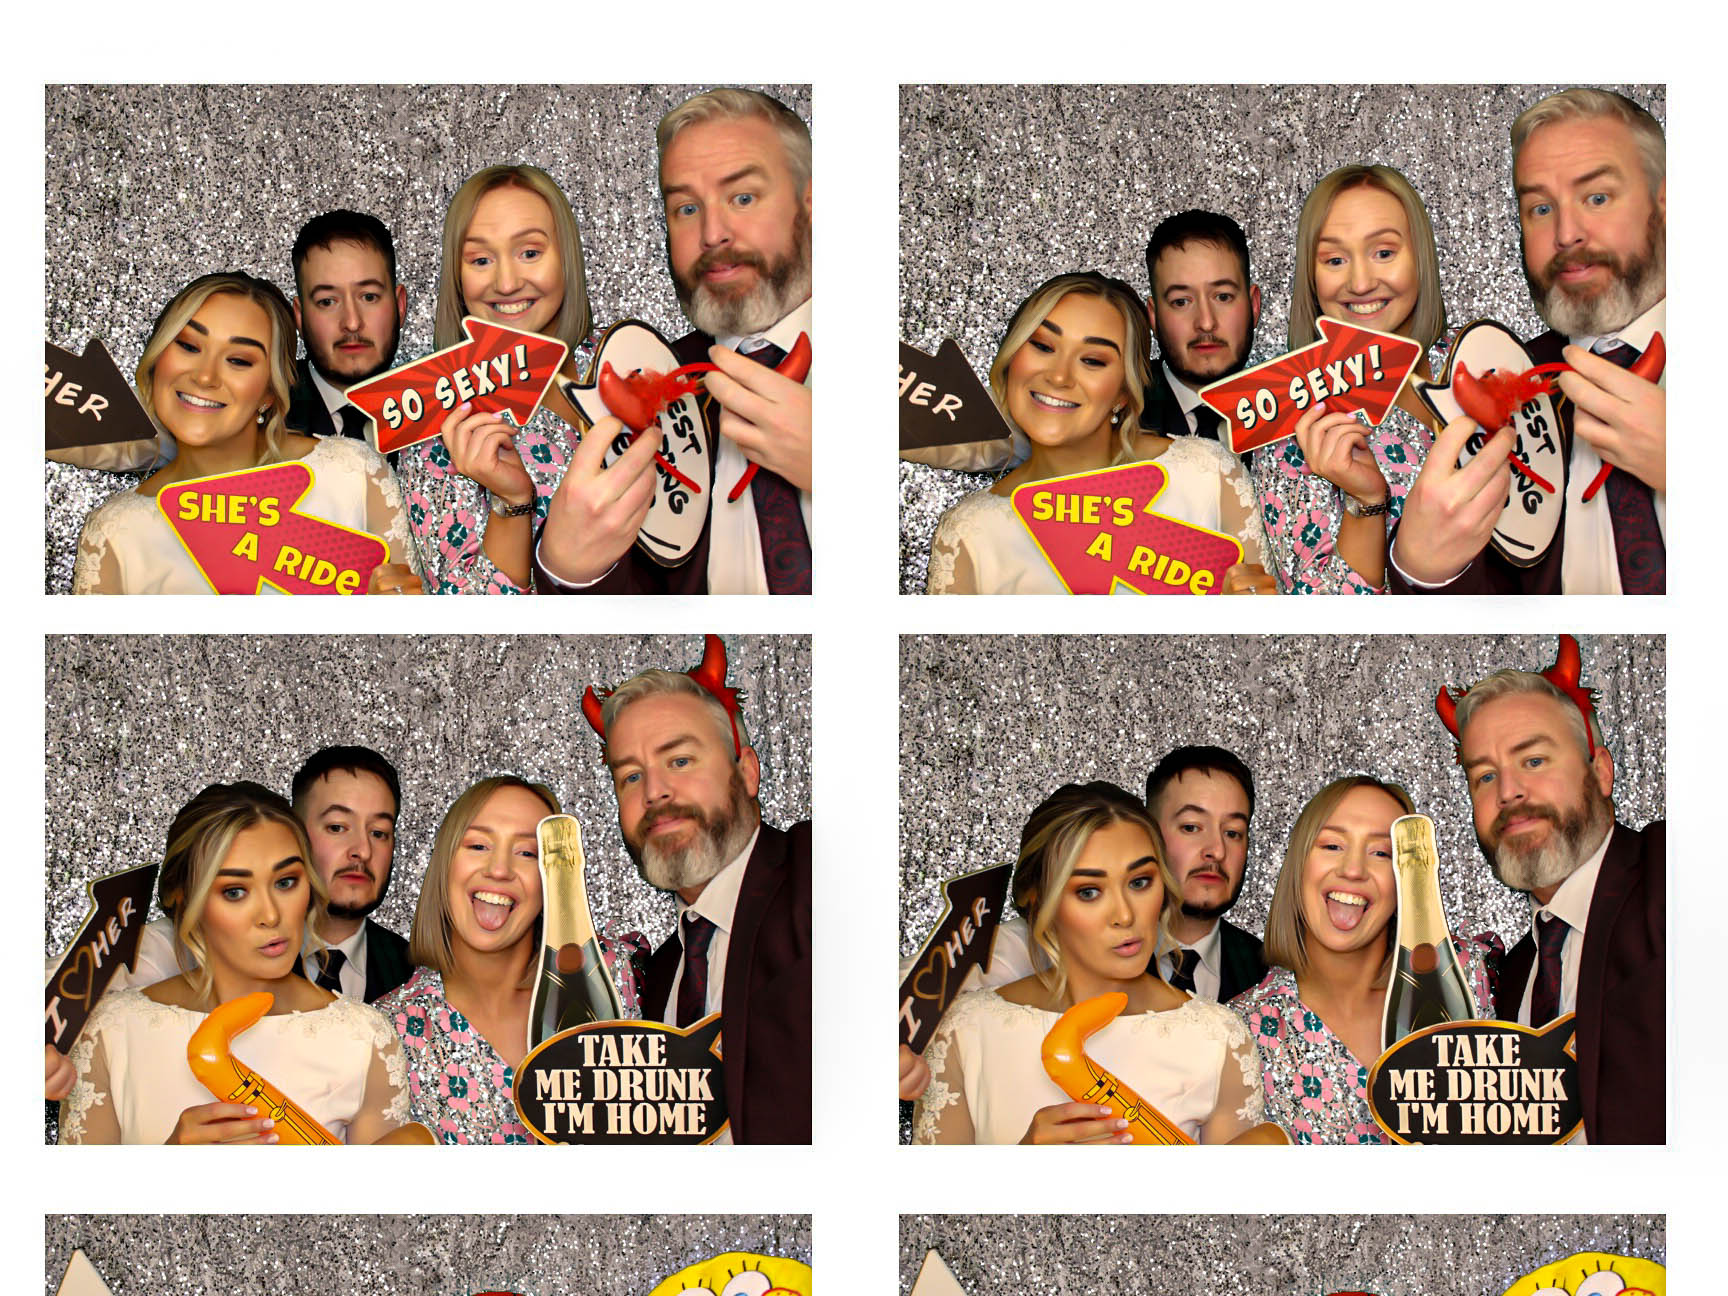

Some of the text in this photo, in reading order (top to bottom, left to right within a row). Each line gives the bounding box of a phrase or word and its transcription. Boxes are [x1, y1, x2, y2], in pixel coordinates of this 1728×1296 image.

[381, 344, 530, 429] SO SEXY!
[1235, 344, 1384, 429] SO SEXY!
[667, 398, 702, 455] EST
[1521, 398, 1556, 455] EST
[178, 491, 280, 527] SHE'S
[1032, 491, 1134, 527] SHE'S
[232, 531, 259, 561] A
[1086, 531, 1113, 561] A
[45, 896, 137, 1043] I HER
[899, 896, 991, 1043] I HER
[578, 1034, 667, 1067] TAKE
[1432, 1034, 1521, 1067] TAKE
[535, 1068, 714, 1101] ME DRUNK
[1389, 1068, 1568, 1101] ME DRUNK
[543, 1103, 707, 1135] I'M HOME
[1397, 1103, 1561, 1135] I'M HOME
